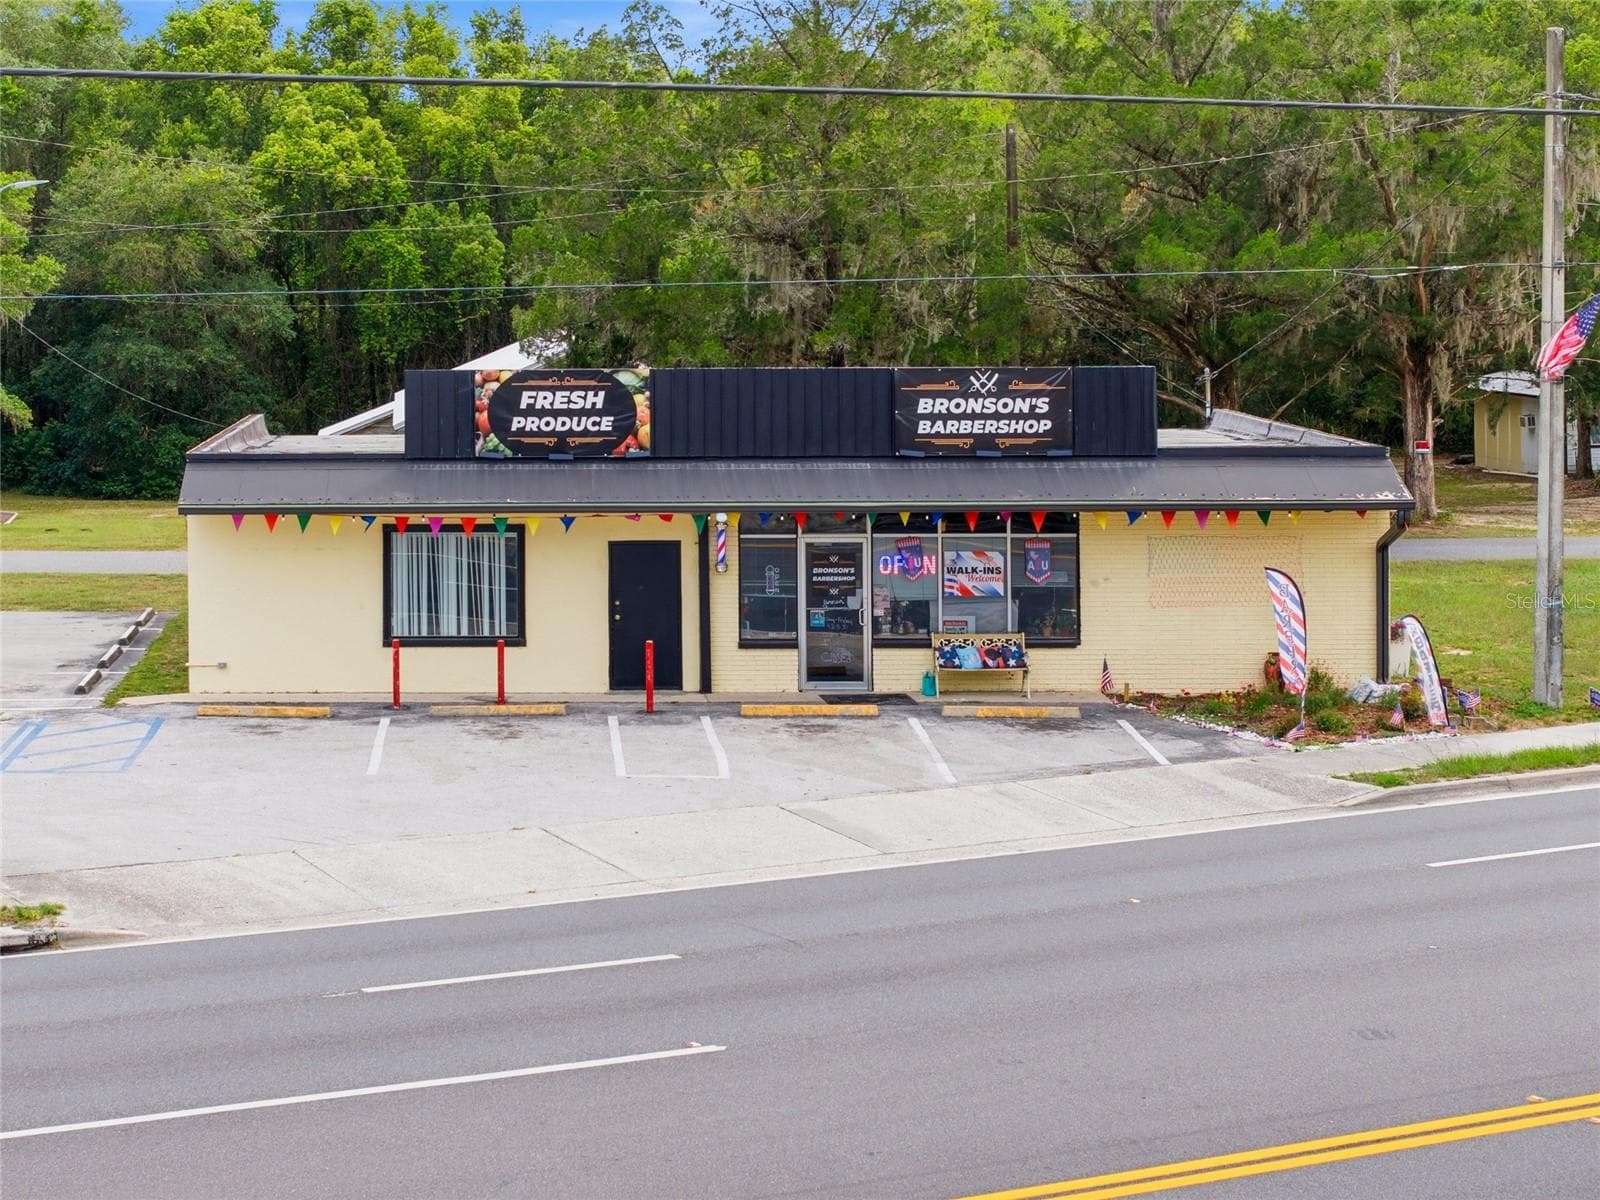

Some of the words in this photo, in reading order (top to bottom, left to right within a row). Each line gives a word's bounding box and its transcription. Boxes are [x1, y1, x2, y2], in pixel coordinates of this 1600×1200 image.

[519, 390, 606, 409] FRESH
[917, 397, 1050, 414] BRONSON'S
[511, 416, 615, 432] PRODUCE
[917, 420, 1053, 434] BARBERSHOP
[946, 566, 1002, 575] WALK-INS
[966, 574, 1001, 583] Welcome
